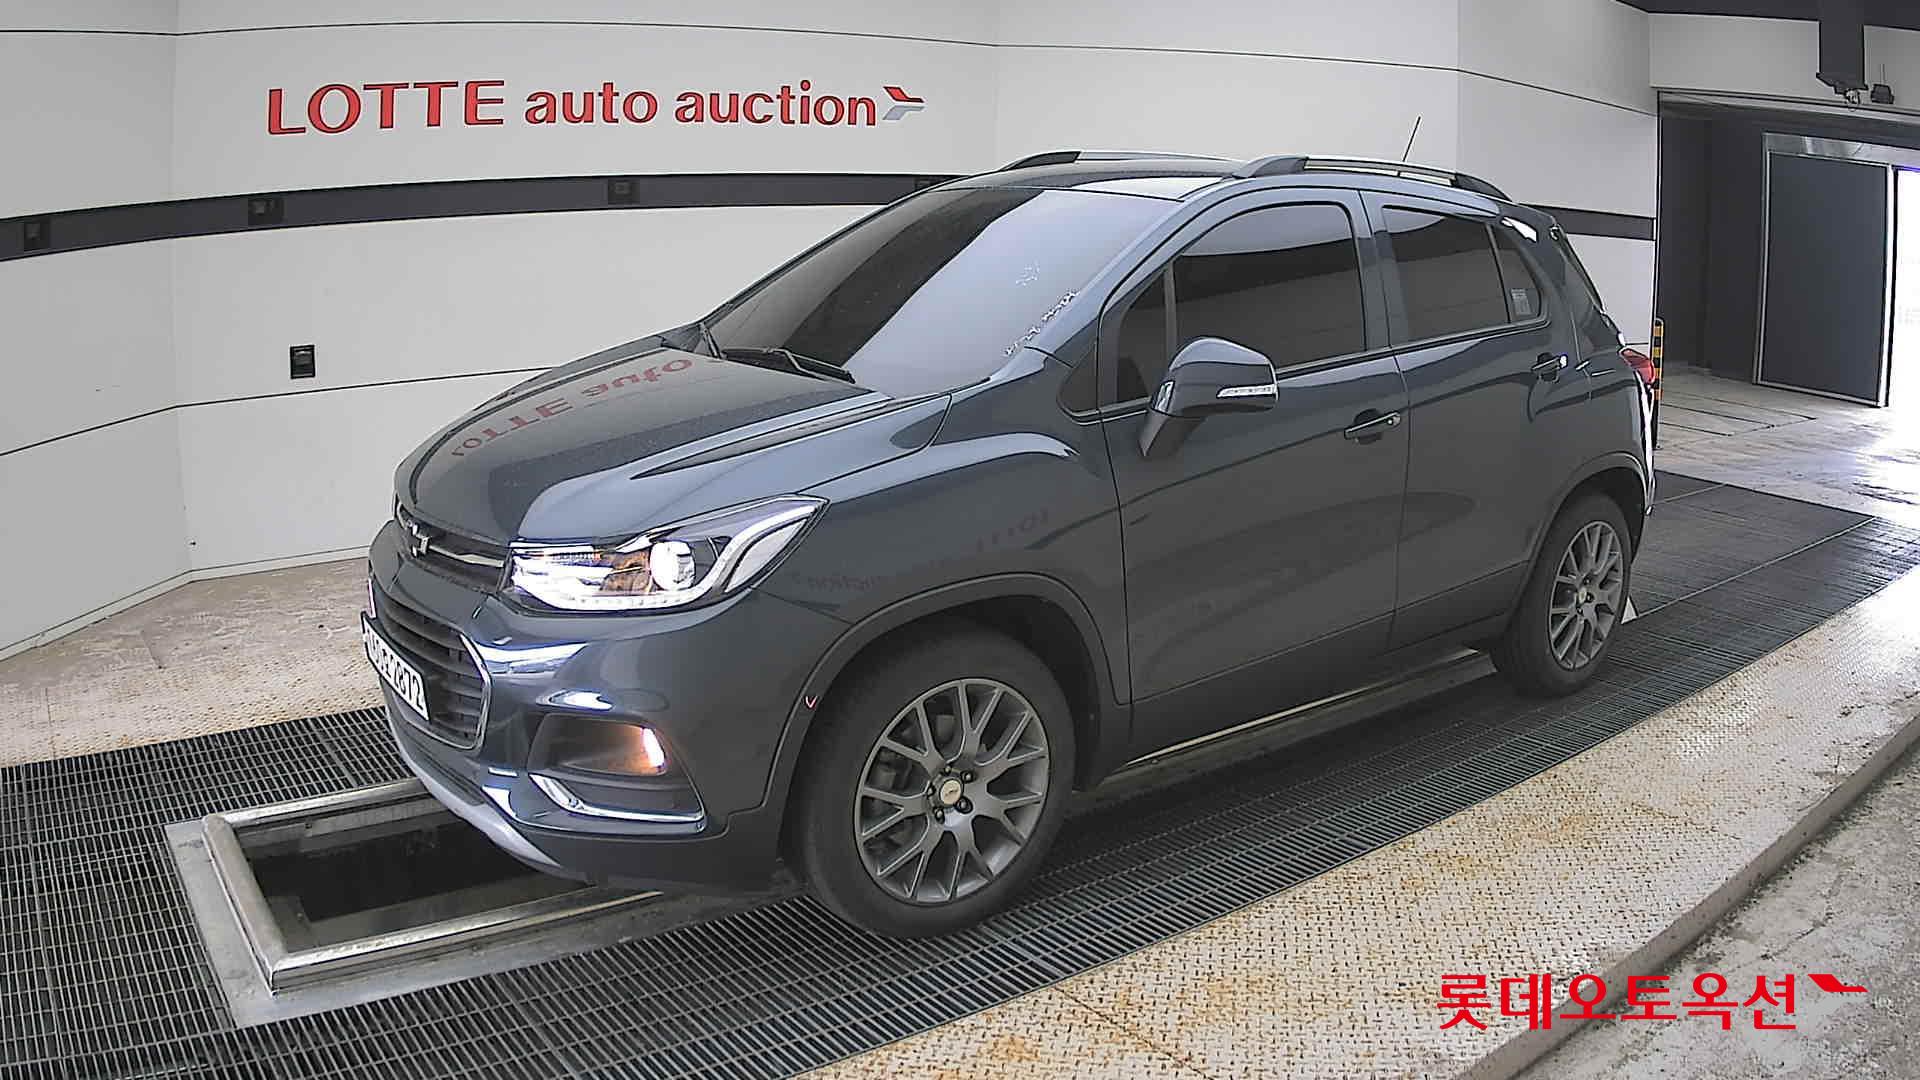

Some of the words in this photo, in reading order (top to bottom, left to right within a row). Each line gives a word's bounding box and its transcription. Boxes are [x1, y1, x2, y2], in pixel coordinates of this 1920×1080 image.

[268, 80, 504, 135] LOTTE
[525, 82, 658, 125] auto
[675, 80, 877, 127] auction
